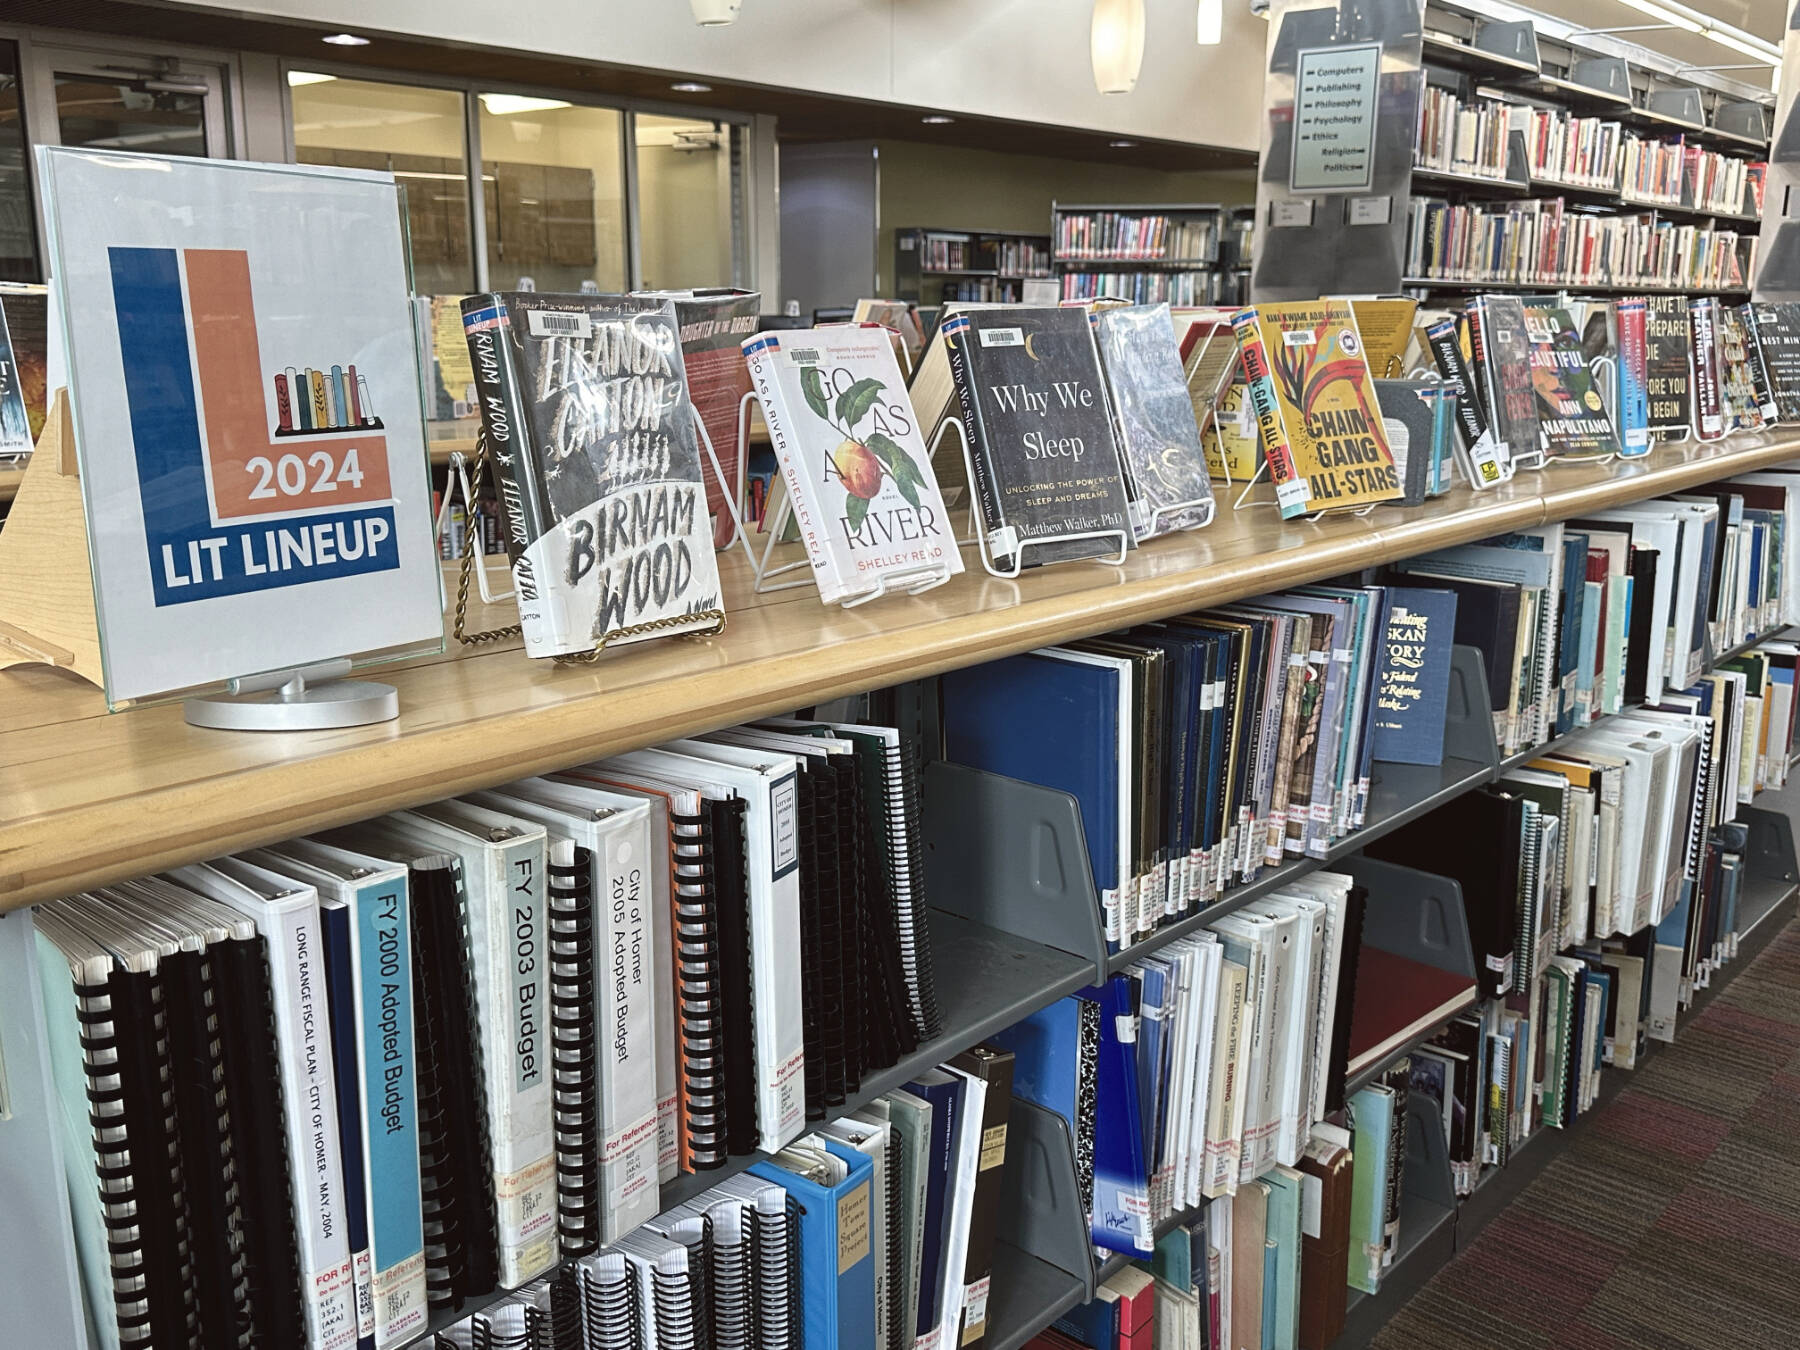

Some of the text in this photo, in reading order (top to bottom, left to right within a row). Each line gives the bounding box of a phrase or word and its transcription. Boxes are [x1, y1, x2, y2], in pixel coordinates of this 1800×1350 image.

[1317, 66, 1364, 77] Computers
[1316, 82, 1361, 92] Publishing
[1315, 98, 1362, 109] Philosophy
[1313, 115, 1362, 126] Psychology
[1312, 132, 1338, 141] Ethics
[1322, 147, 1355, 156] Religion
[1649, 296, 1685, 313] HAVE TO
[472, 314, 481, 322] LIT
[730, 315, 758, 334] DRAGON
[1762, 337, 1780, 345] BEST
[1528, 351, 1588, 369] EAUTIFUL
[807, 367, 855, 402] GO
[1669, 377, 1686, 394] YOU
[1707, 377, 1715, 406] JOHN
[990, 381, 1093, 417] Why We
[1558, 400, 1582, 415] ANN
[1653, 400, 1680, 418] BEGIN
[872, 405, 912, 438] AS
[951, 354, 988, 489] Why We Sleep Matthew
[1542, 419, 1611, 435] NAPOLITANO
[752, 356, 811, 526] GO AS A RIVER SHELLEY
[1022, 432, 1084, 462] Sleep
[1318, 437, 1379, 469] GANG
[244, 449, 364, 500] 2024
[487, 396, 511, 442] WOOD
[500, 478, 527, 546] ELEANOR
[823, 449, 848, 482] A
[1481, 461, 1494, 474] LP
[1005, 475, 1118, 494] UNLOCKING THE POWER OF
[1311, 465, 1400, 501] ALL-STARS
[1026, 491, 1108, 506] SLEEP AND DREAMS
[566, 485, 696, 588] BIRNAM
[839, 505, 940, 550] RIVER
[1019, 512, 1122, 537] Matthew Walker, PhD
[161, 516, 390, 589] LIT LINEUP
[857, 546, 943, 571] SHELLEY READ
[590, 539, 692, 640] WOOD
[1228, 661, 1238, 711] HOMER
[1224, 718, 1233, 753] HIGH
[627, 869, 642, 985] City of Homer
[295, 926, 308, 961] LONG
[513, 858, 538, 1080] FY 2003 Budget
[611, 876, 629, 1064] 2005 Adopted Budget
[298, 962, 311, 1003] RANGE
[377, 893, 403, 1135] FY 2000 Adopted Budget
[1231, 982, 1242, 1024] KEEPING
[301, 1004, 315, 1044] FISCAL
[305, 1045, 317, 1075] PLAN
[1228, 1038, 1238, 1060] FIRE
[1224, 1063, 1234, 1102] BURNING
[309, 1085, 320, 1111] CITY
[312, 1112, 322, 1129] OF
[606, 1140, 620, 1152] For
[621, 1116, 656, 1143] Reference
[314, 1130, 327, 1174] HOMER
[503, 1176, 520, 1186] For
[840, 1193, 867, 1217] Homer
[1125, 1197, 1137, 1205] FOR
[320, 1208, 332, 1240] 2004
[843, 1210, 865, 1228] Town
[840, 1222, 866, 1244] Square
[840, 1233, 867, 1258] Project
[315, 1270, 338, 1286] FOR
[320, 1297, 335, 1307] REF
[321, 1303, 344, 1318] 352.1
[322, 1314, 344, 1329] (AKA)
[386, 1315, 422, 1337] COLLECTION
[388, 1310, 420, 1330] ALASKANA
[323, 1328, 335, 1338] CIT
